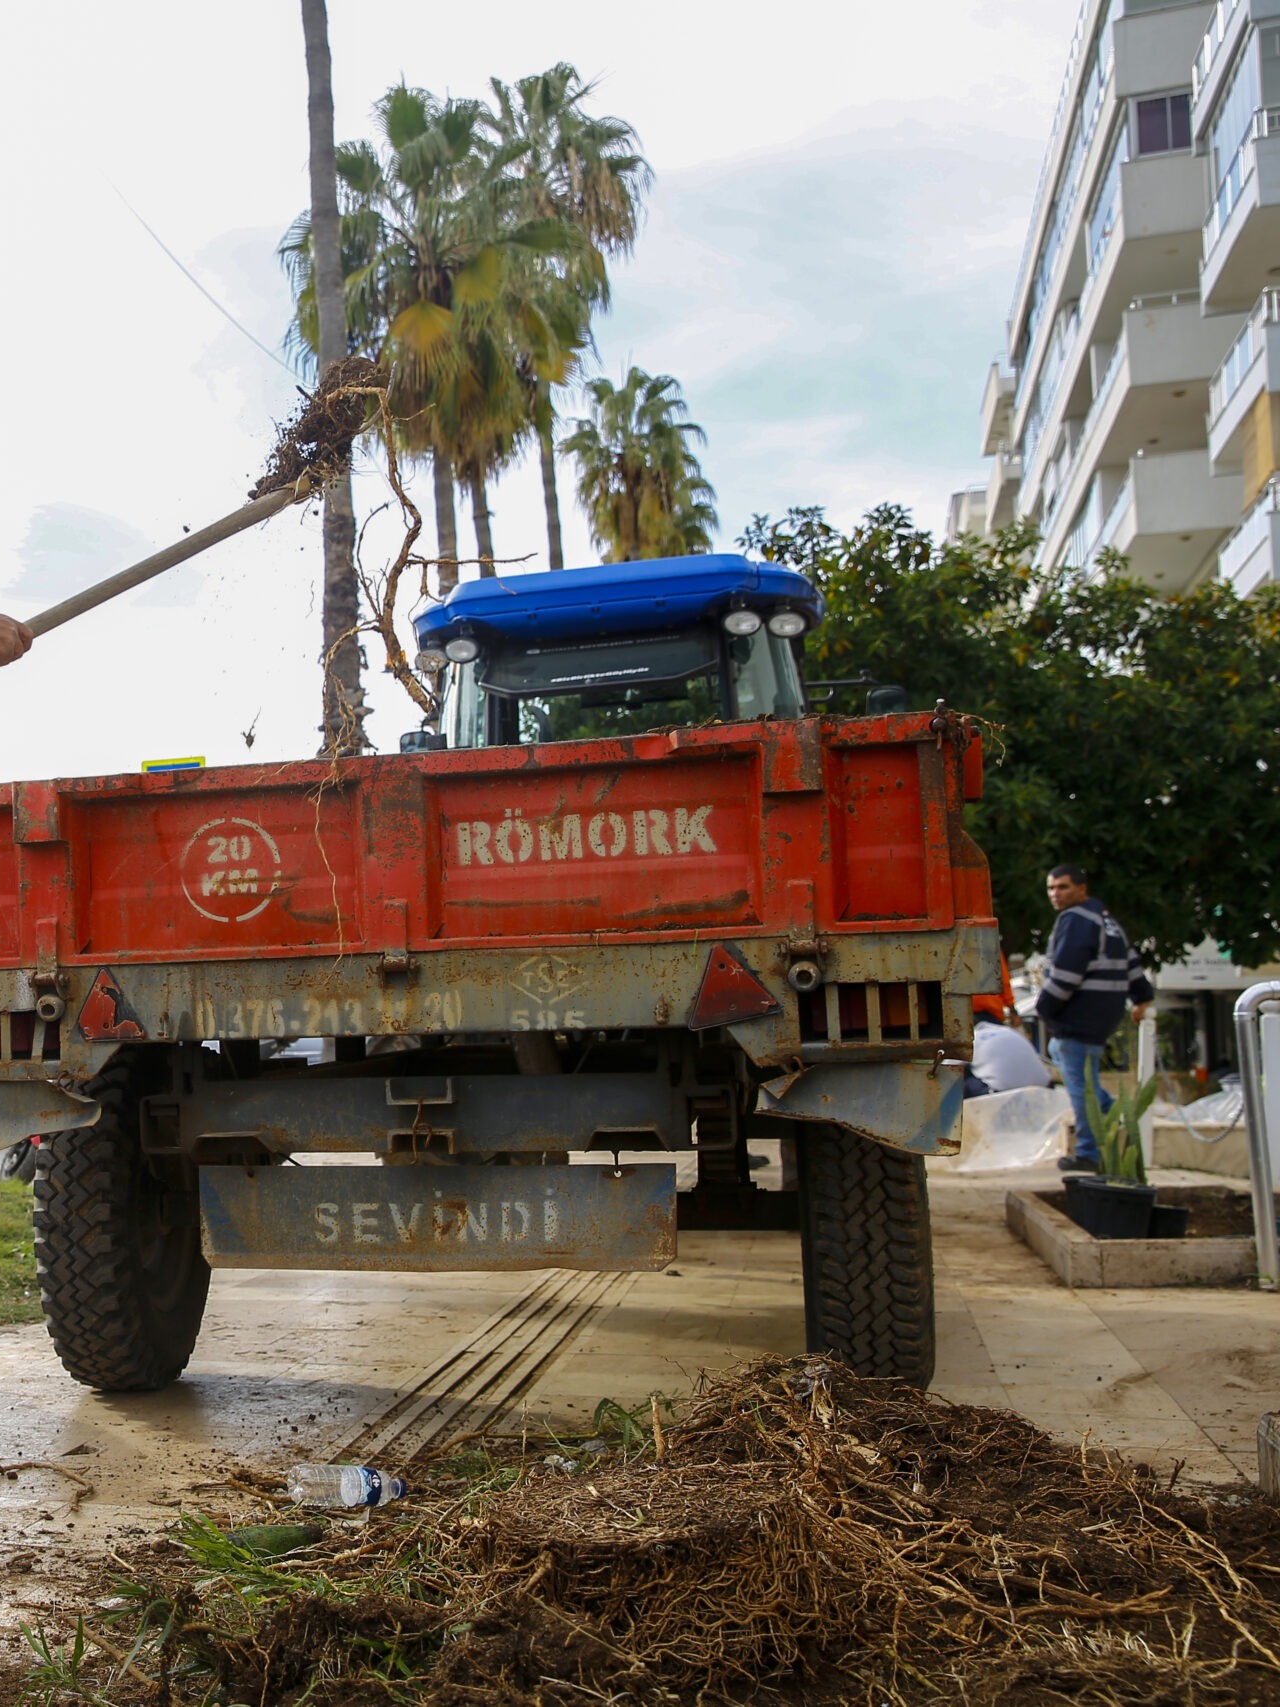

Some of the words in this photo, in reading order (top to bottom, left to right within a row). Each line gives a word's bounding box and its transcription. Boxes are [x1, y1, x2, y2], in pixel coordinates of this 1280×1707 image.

[207, 835, 251, 863] 20
[456, 805, 718, 866] RÖMORK
[201, 869, 258, 896] KM
